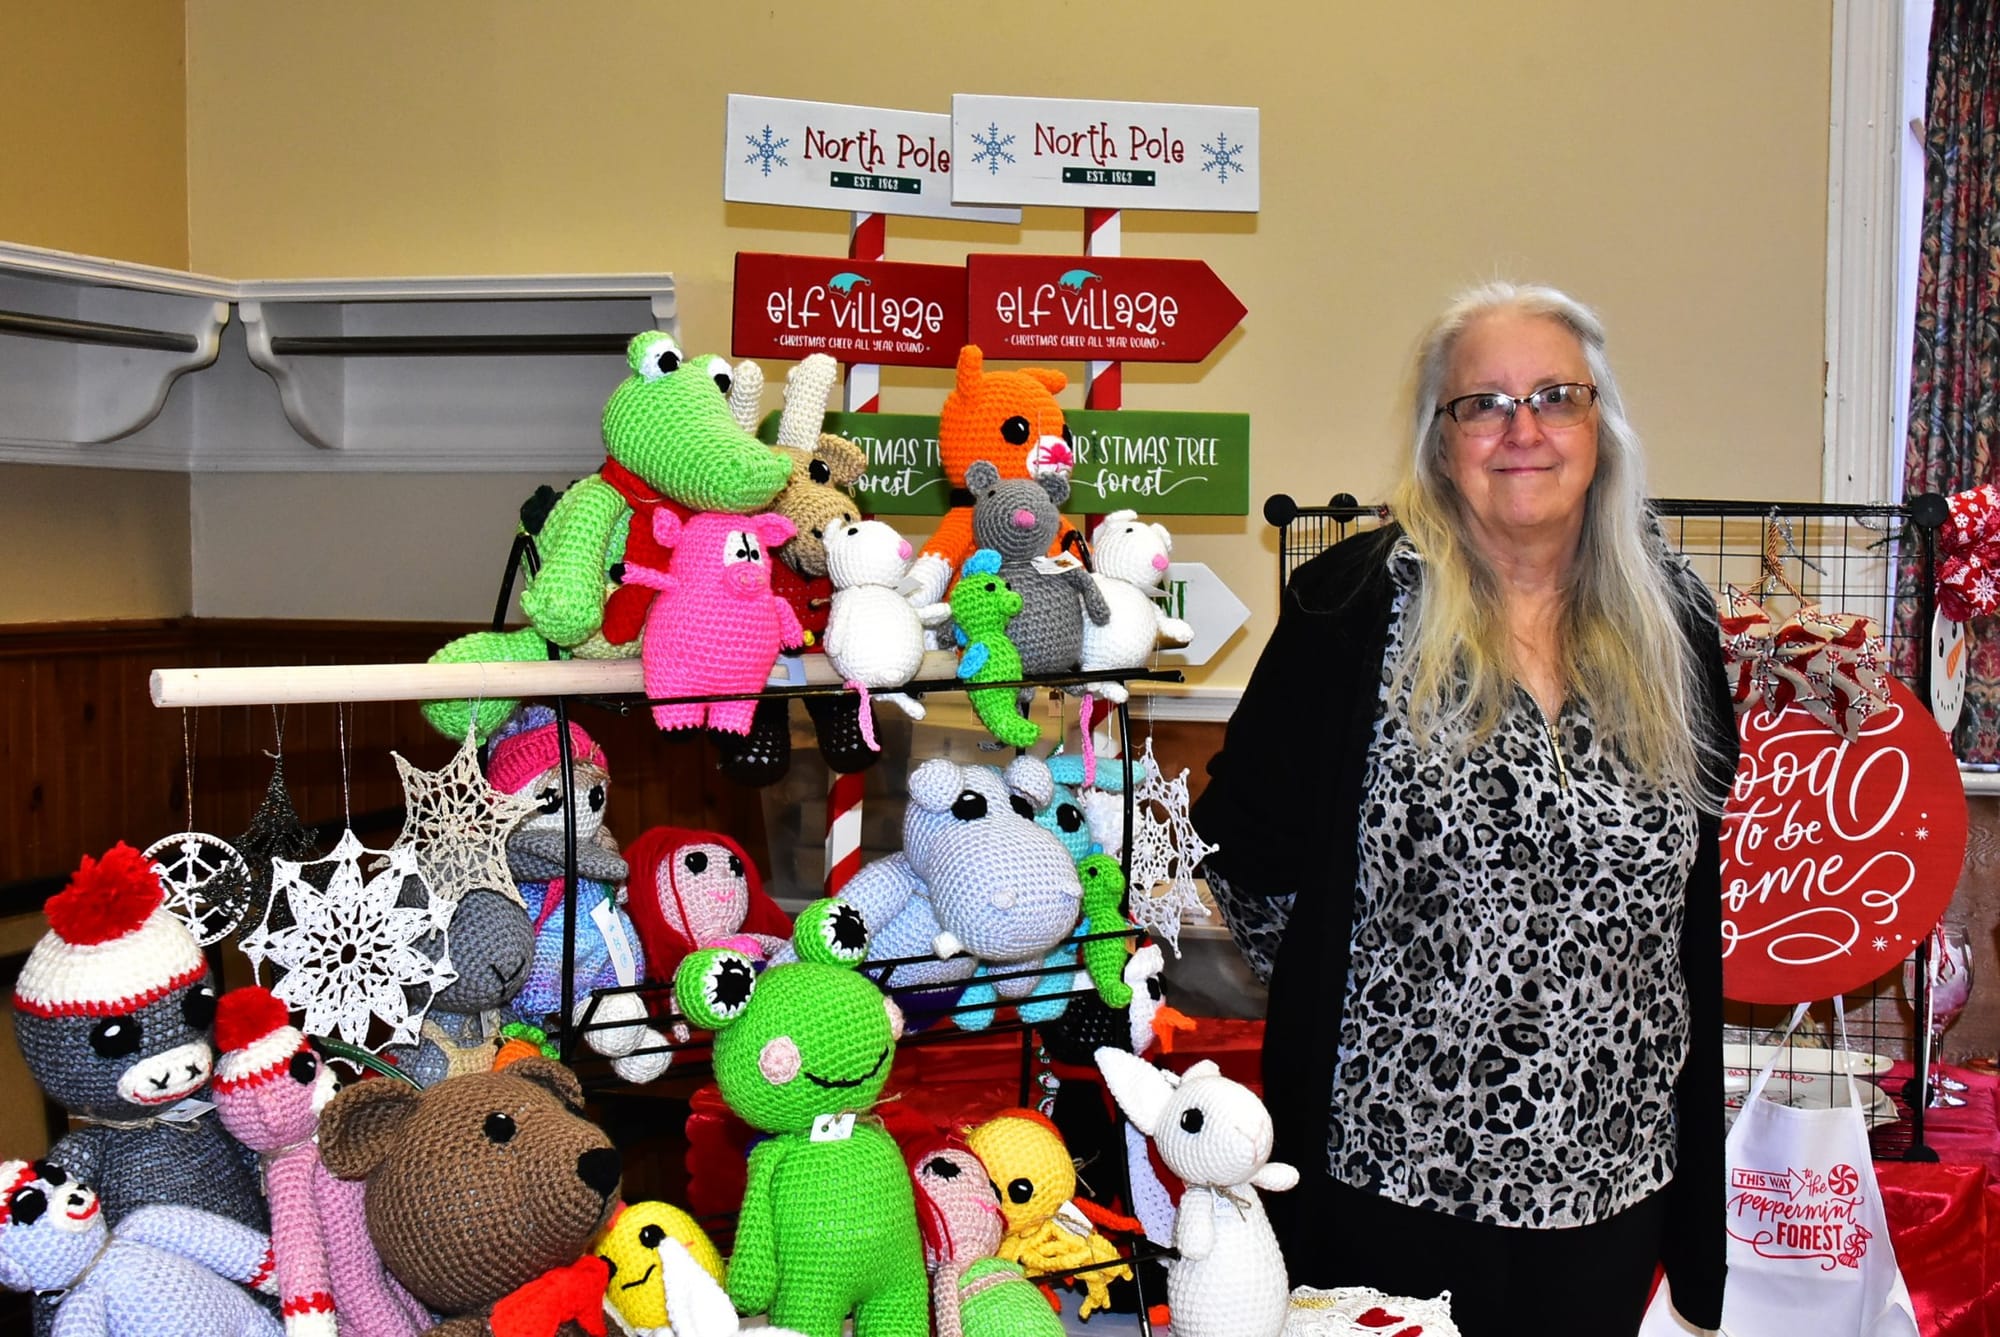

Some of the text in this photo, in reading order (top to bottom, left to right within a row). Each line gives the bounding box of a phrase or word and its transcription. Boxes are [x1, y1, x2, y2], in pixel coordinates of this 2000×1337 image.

[803, 125, 951, 173] North Pole
[1034, 122, 1184, 167] North Pole
[853, 176, 899, 190] EST. 1863
[1086, 170, 1133, 183] EST. 1863
[767, 285, 944, 339] elf village
[996, 284, 1179, 334] elf village
[779, 335, 925, 353] CHRISTMAS CHEER ALL YEAR ROUND
[1010, 335, 1159, 349] CHRISTMAS CHEER ALL YEAR ROUND
[1174, 437, 1221, 466] TREE
[1094, 466, 1208, 499] forest
[1722, 796, 1823, 867] to be
[1738, 1172, 1792, 1189] THIS WAY
[1801, 1168, 1813, 1180] to
[1806, 1175, 1827, 1198] the
[1727, 1192, 1864, 1224] peppermint
[1776, 1221, 1843, 1250] FOREST
